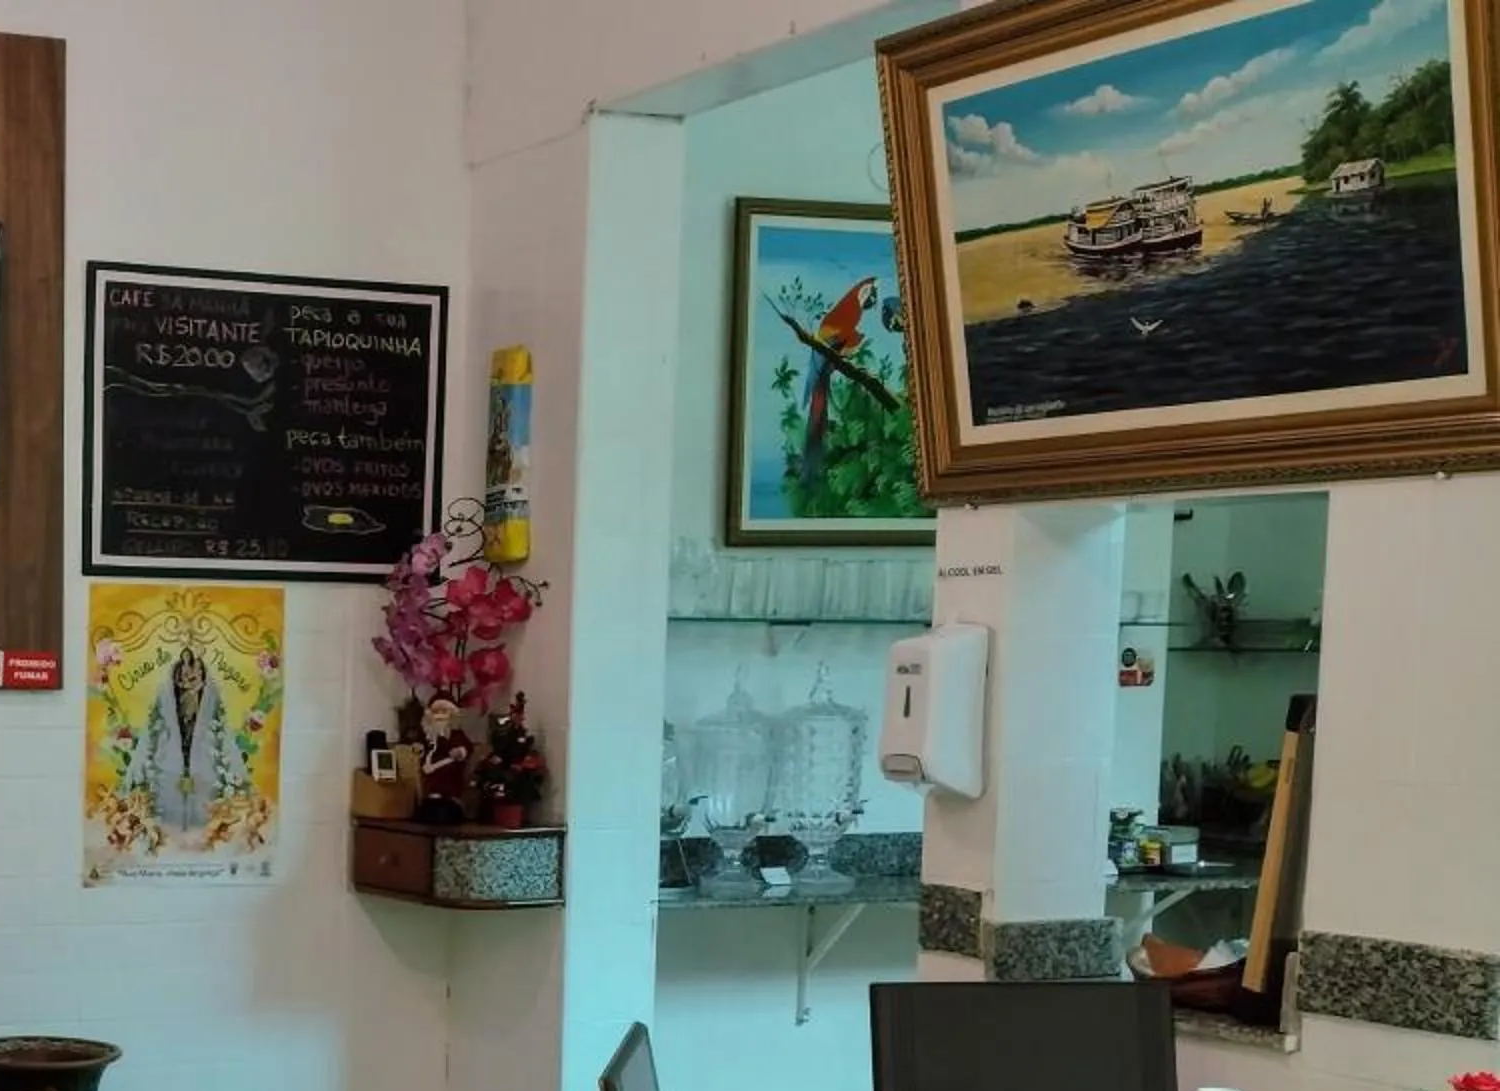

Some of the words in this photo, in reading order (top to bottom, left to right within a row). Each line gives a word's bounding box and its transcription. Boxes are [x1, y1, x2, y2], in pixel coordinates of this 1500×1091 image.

[155, 315, 261, 344] VISITANTE
[284, 327, 423, 358] TAPIOQUINHA
[13, 671, 49, 681] FUMAR
